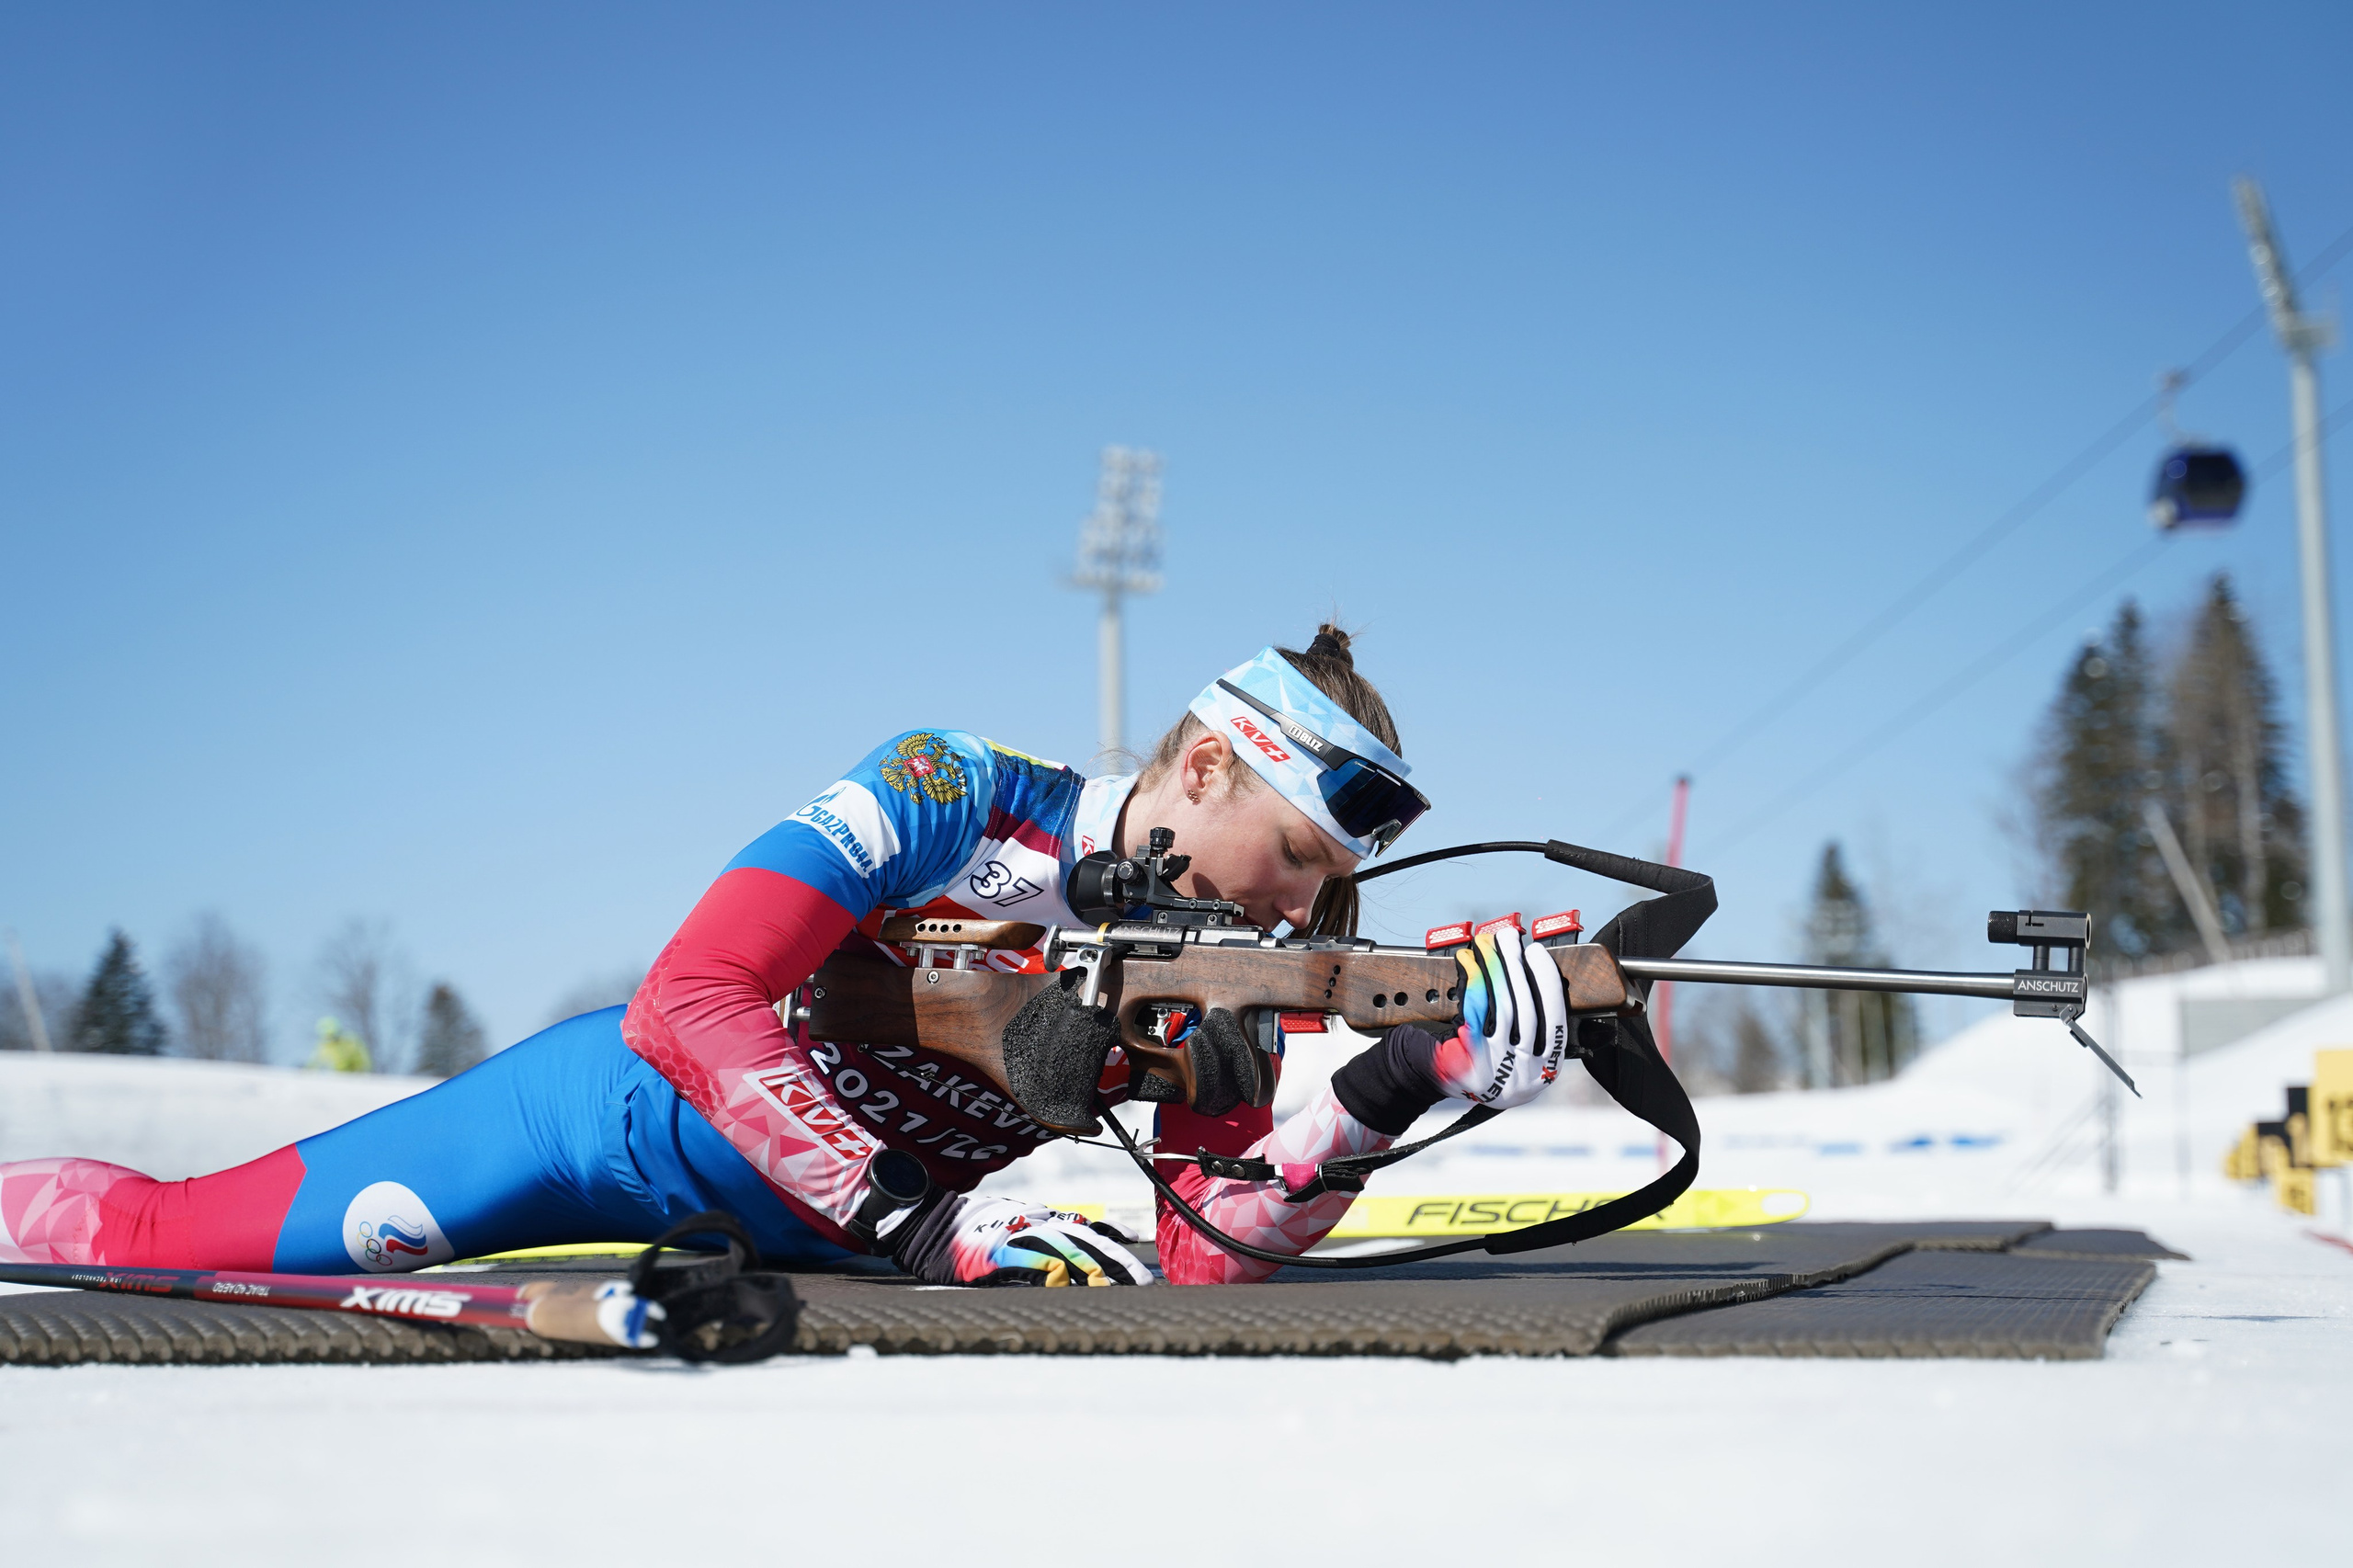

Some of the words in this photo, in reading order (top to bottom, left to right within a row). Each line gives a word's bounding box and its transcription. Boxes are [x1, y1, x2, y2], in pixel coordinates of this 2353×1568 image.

[970, 860, 1045, 907] 37
[1407, 1199, 1662, 1226] FISCH
[339, 1286, 472, 1318] SWIX
